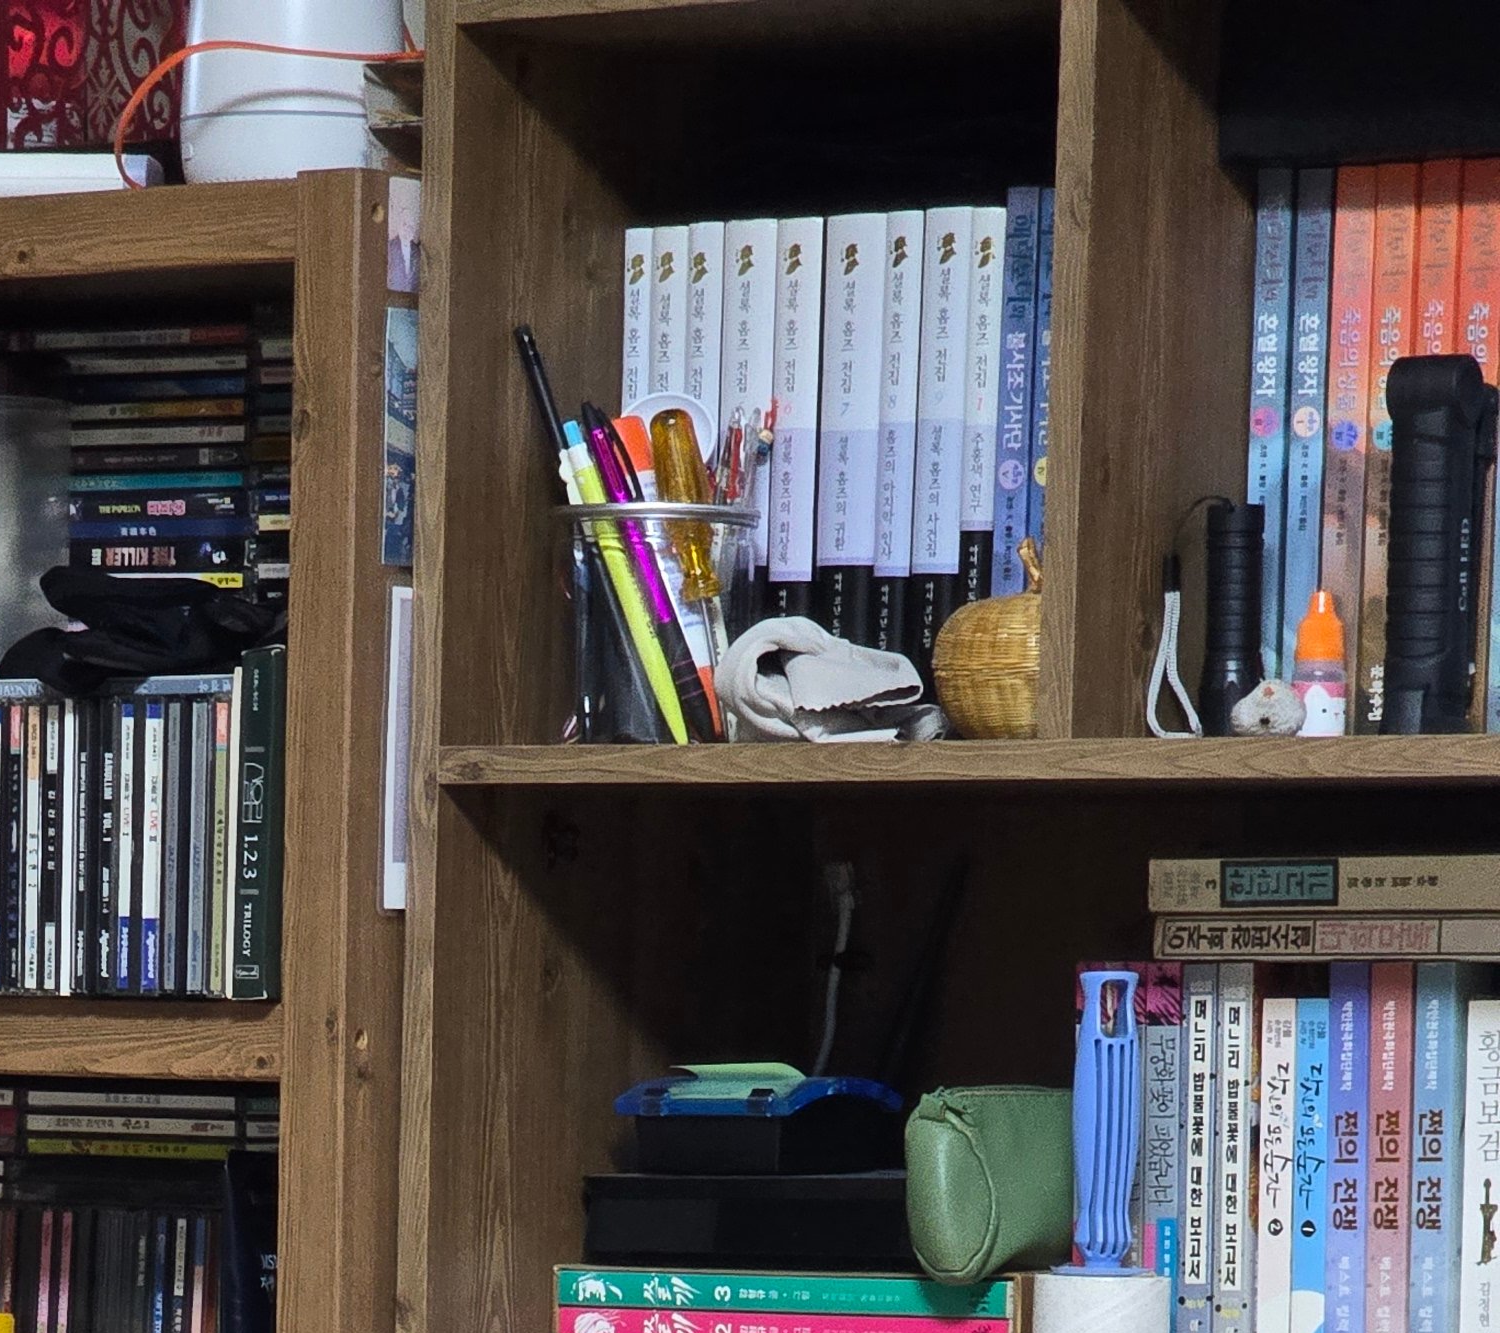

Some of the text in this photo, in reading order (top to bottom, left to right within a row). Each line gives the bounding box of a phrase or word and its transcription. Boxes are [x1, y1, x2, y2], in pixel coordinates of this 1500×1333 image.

[1255, 311, 1279, 398] 혼혈왕자
[105, 547, 149, 566] KILLER
[241, 902, 253, 957] TRILOGY
[1148, 1125, 1174, 1206] 피었습니다
[1188, 1000, 1207, 1281] 며느리 밥풀꽃에 대한 보고서
[1223, 1006, 1241, 1287] 며느리 대한 보고서
[1265, 1062, 1292, 1210] 당신의 모든 순간
[1331, 1110, 1360, 1231] 쩐의 전쟁
[1373, 1177, 1399, 1231] 전쟁
[714, 1285, 733, 1302] 3
